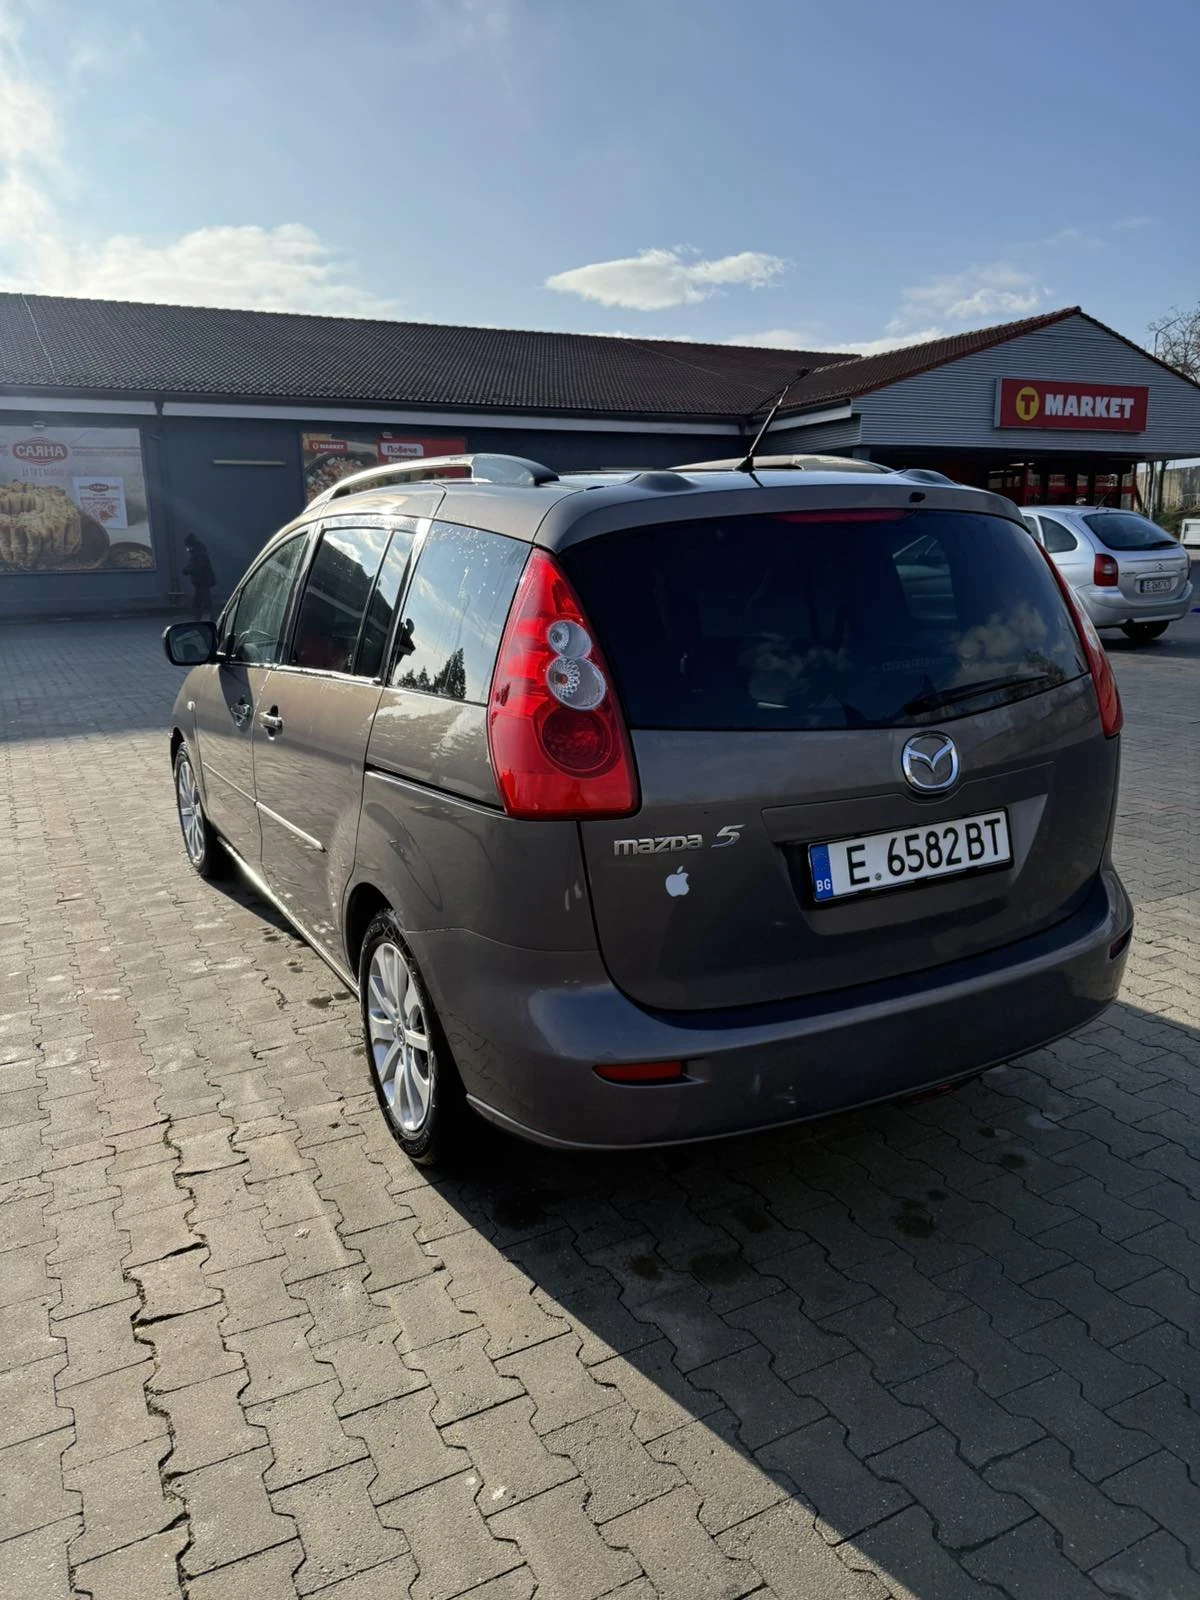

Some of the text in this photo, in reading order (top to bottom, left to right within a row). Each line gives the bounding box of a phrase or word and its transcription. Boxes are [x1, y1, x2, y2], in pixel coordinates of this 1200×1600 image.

[1044, 393, 1135, 419] MARKET
[15, 445, 65, 458] САЯНА
[387, 445, 418, 454] Повече
[816, 878, 832, 892] BG
